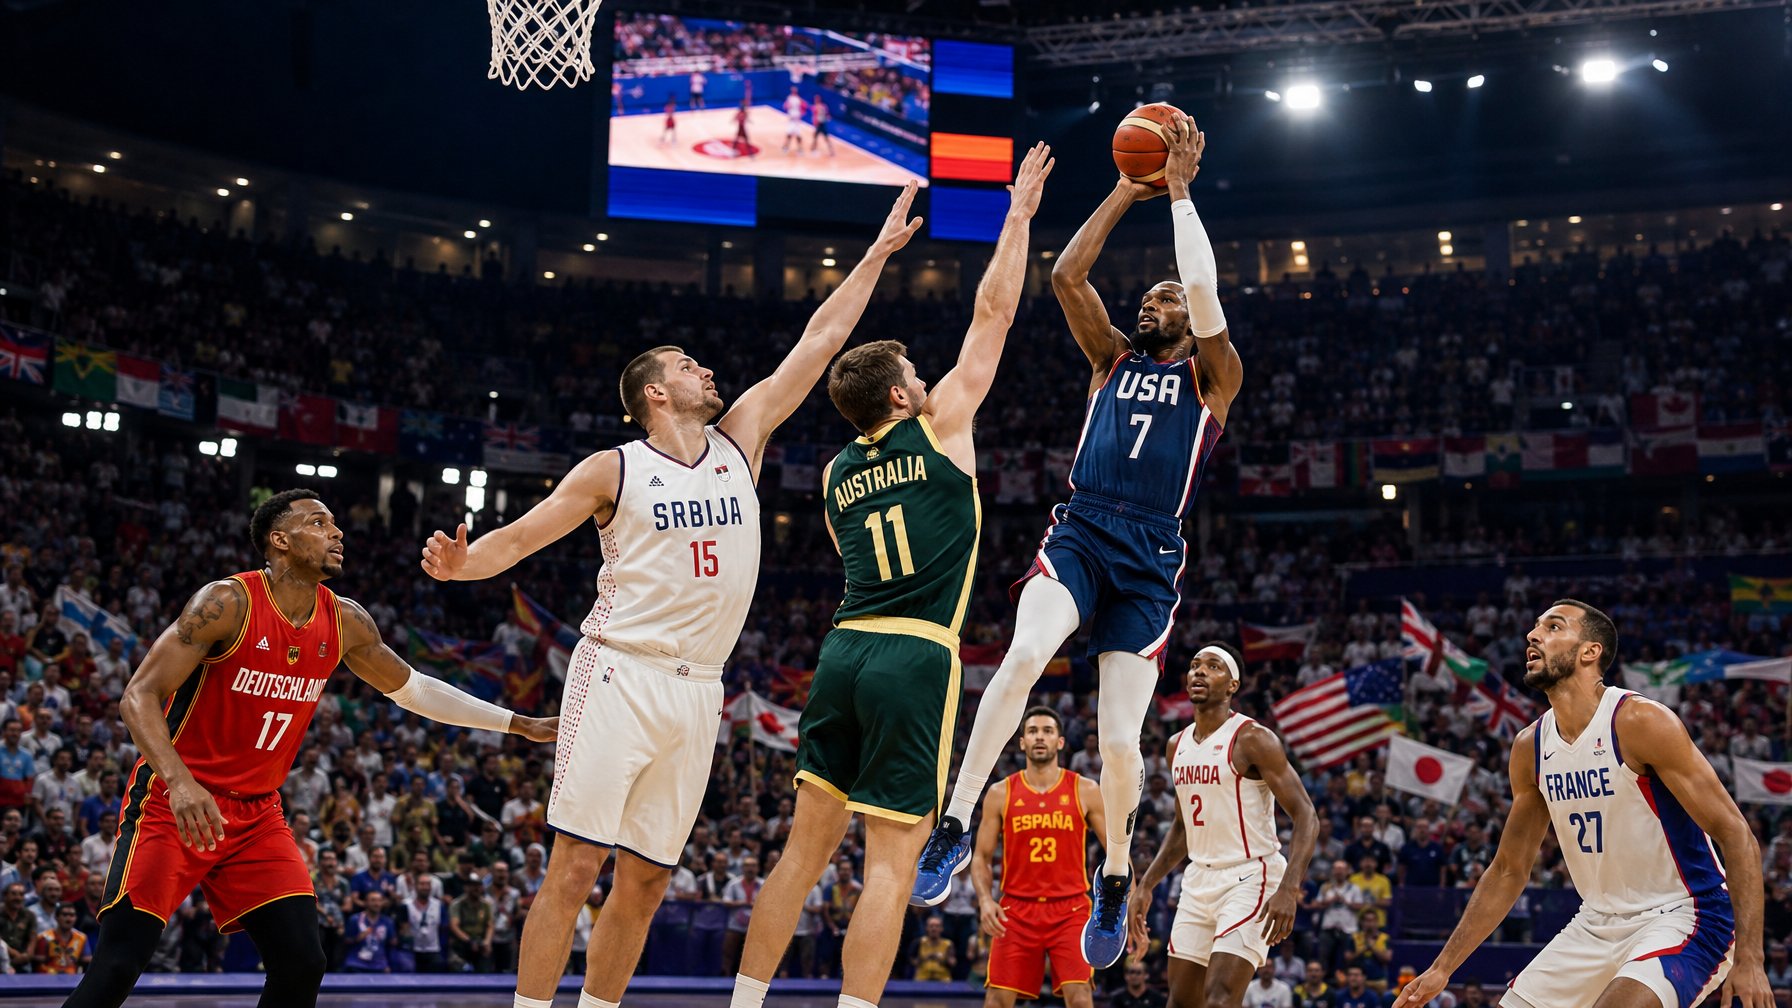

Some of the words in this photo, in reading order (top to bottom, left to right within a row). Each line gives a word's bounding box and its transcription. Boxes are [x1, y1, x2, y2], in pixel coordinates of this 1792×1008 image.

[1116, 370, 1181, 406] USA
[1129, 413, 1153, 459] 7
[834, 455, 927, 513] AUSTRALIA
[653, 496, 743, 531] SRBIJA
[689, 540, 719, 577] 15
[864, 504, 915, 582] 11
[255, 711, 294, 751] 17
[1173, 765, 1221, 786] CANADA
[1545, 767, 1615, 802] FRANCE
[1012, 810, 1074, 834] ESPAÑA
[1190, 794, 1205, 827] 2
[1029, 836, 1057, 863] 23
[1569, 811, 1603, 854] 27
